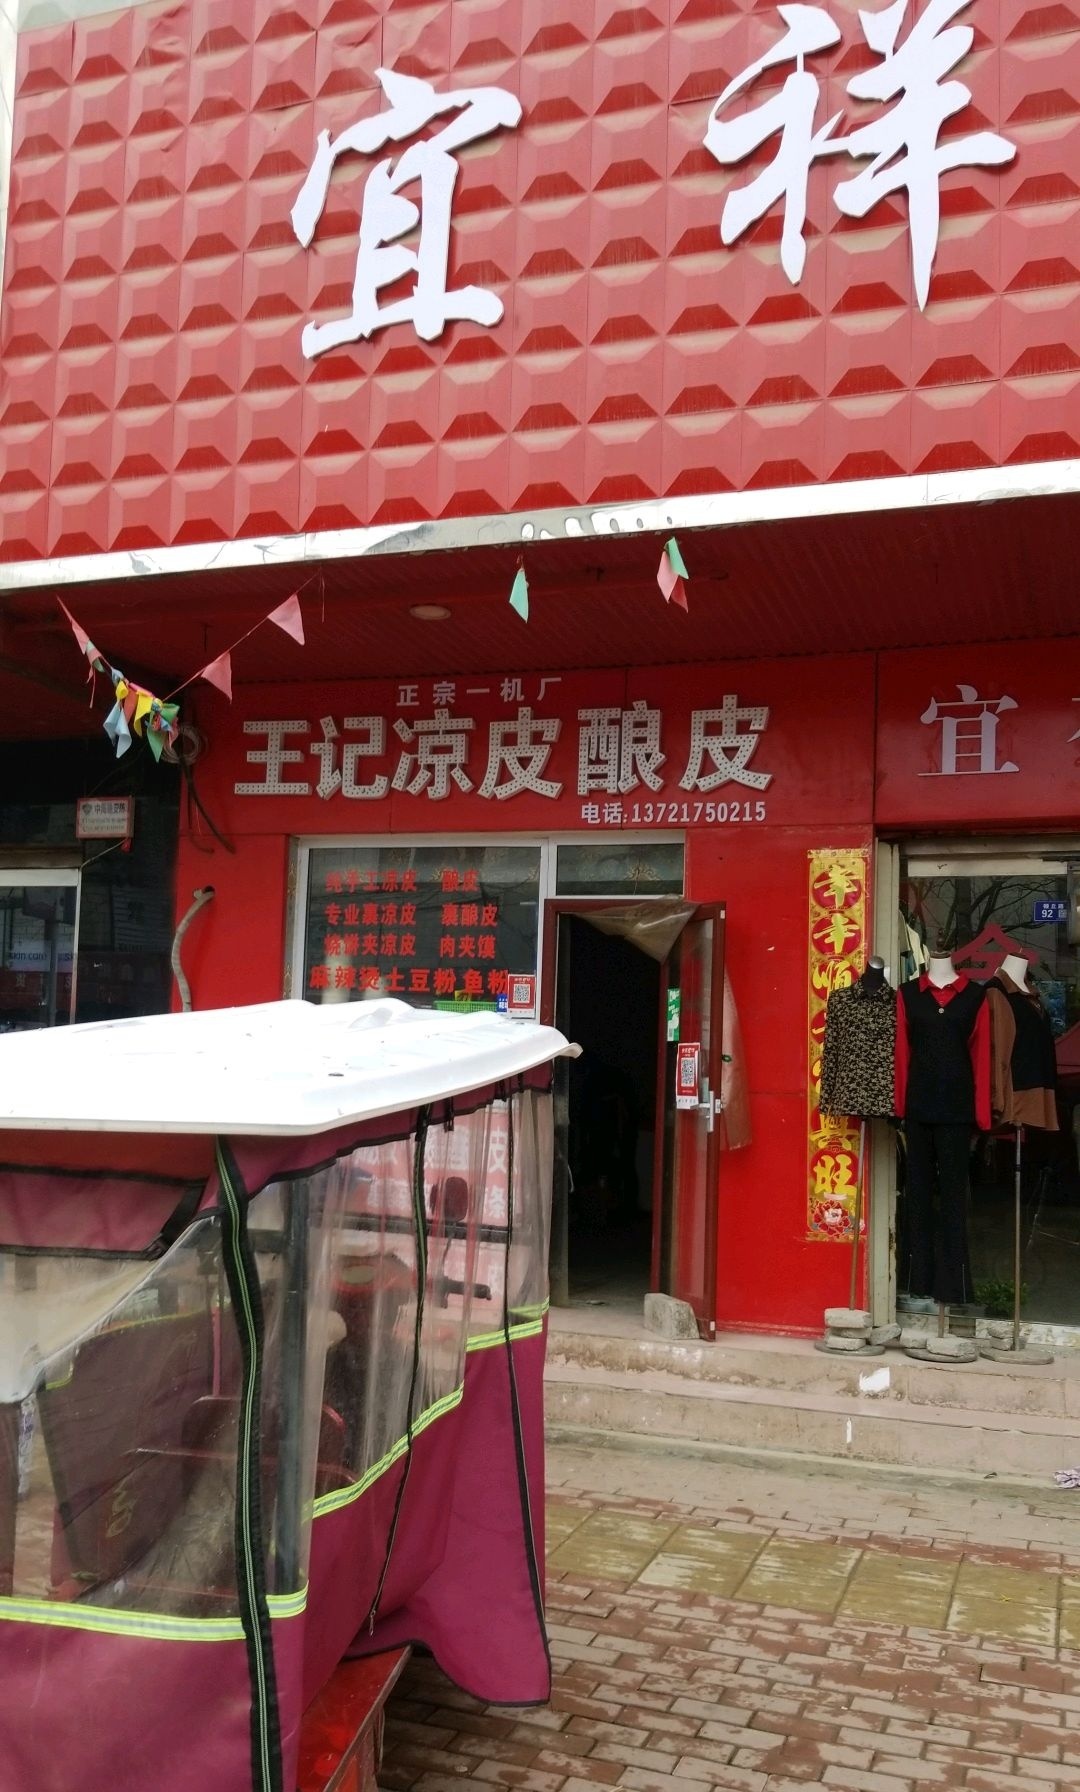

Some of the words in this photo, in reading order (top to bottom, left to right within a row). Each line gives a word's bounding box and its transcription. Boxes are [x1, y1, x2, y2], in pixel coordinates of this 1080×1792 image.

[290, 0, 1017, 360] 宜祥
[397, 677, 562, 707] 正宗一机厂
[917, 684, 1080, 777] 宜
[234, 694, 774, 801] 王记凉皮酿皮
[441, 868, 479, 892] 酿皮
[1041, 909, 1053, 918] 92
[439, 934, 496, 959] 肉夹馍
[309, 965, 509, 995] 麻辣烫土豆粉鱼粉
